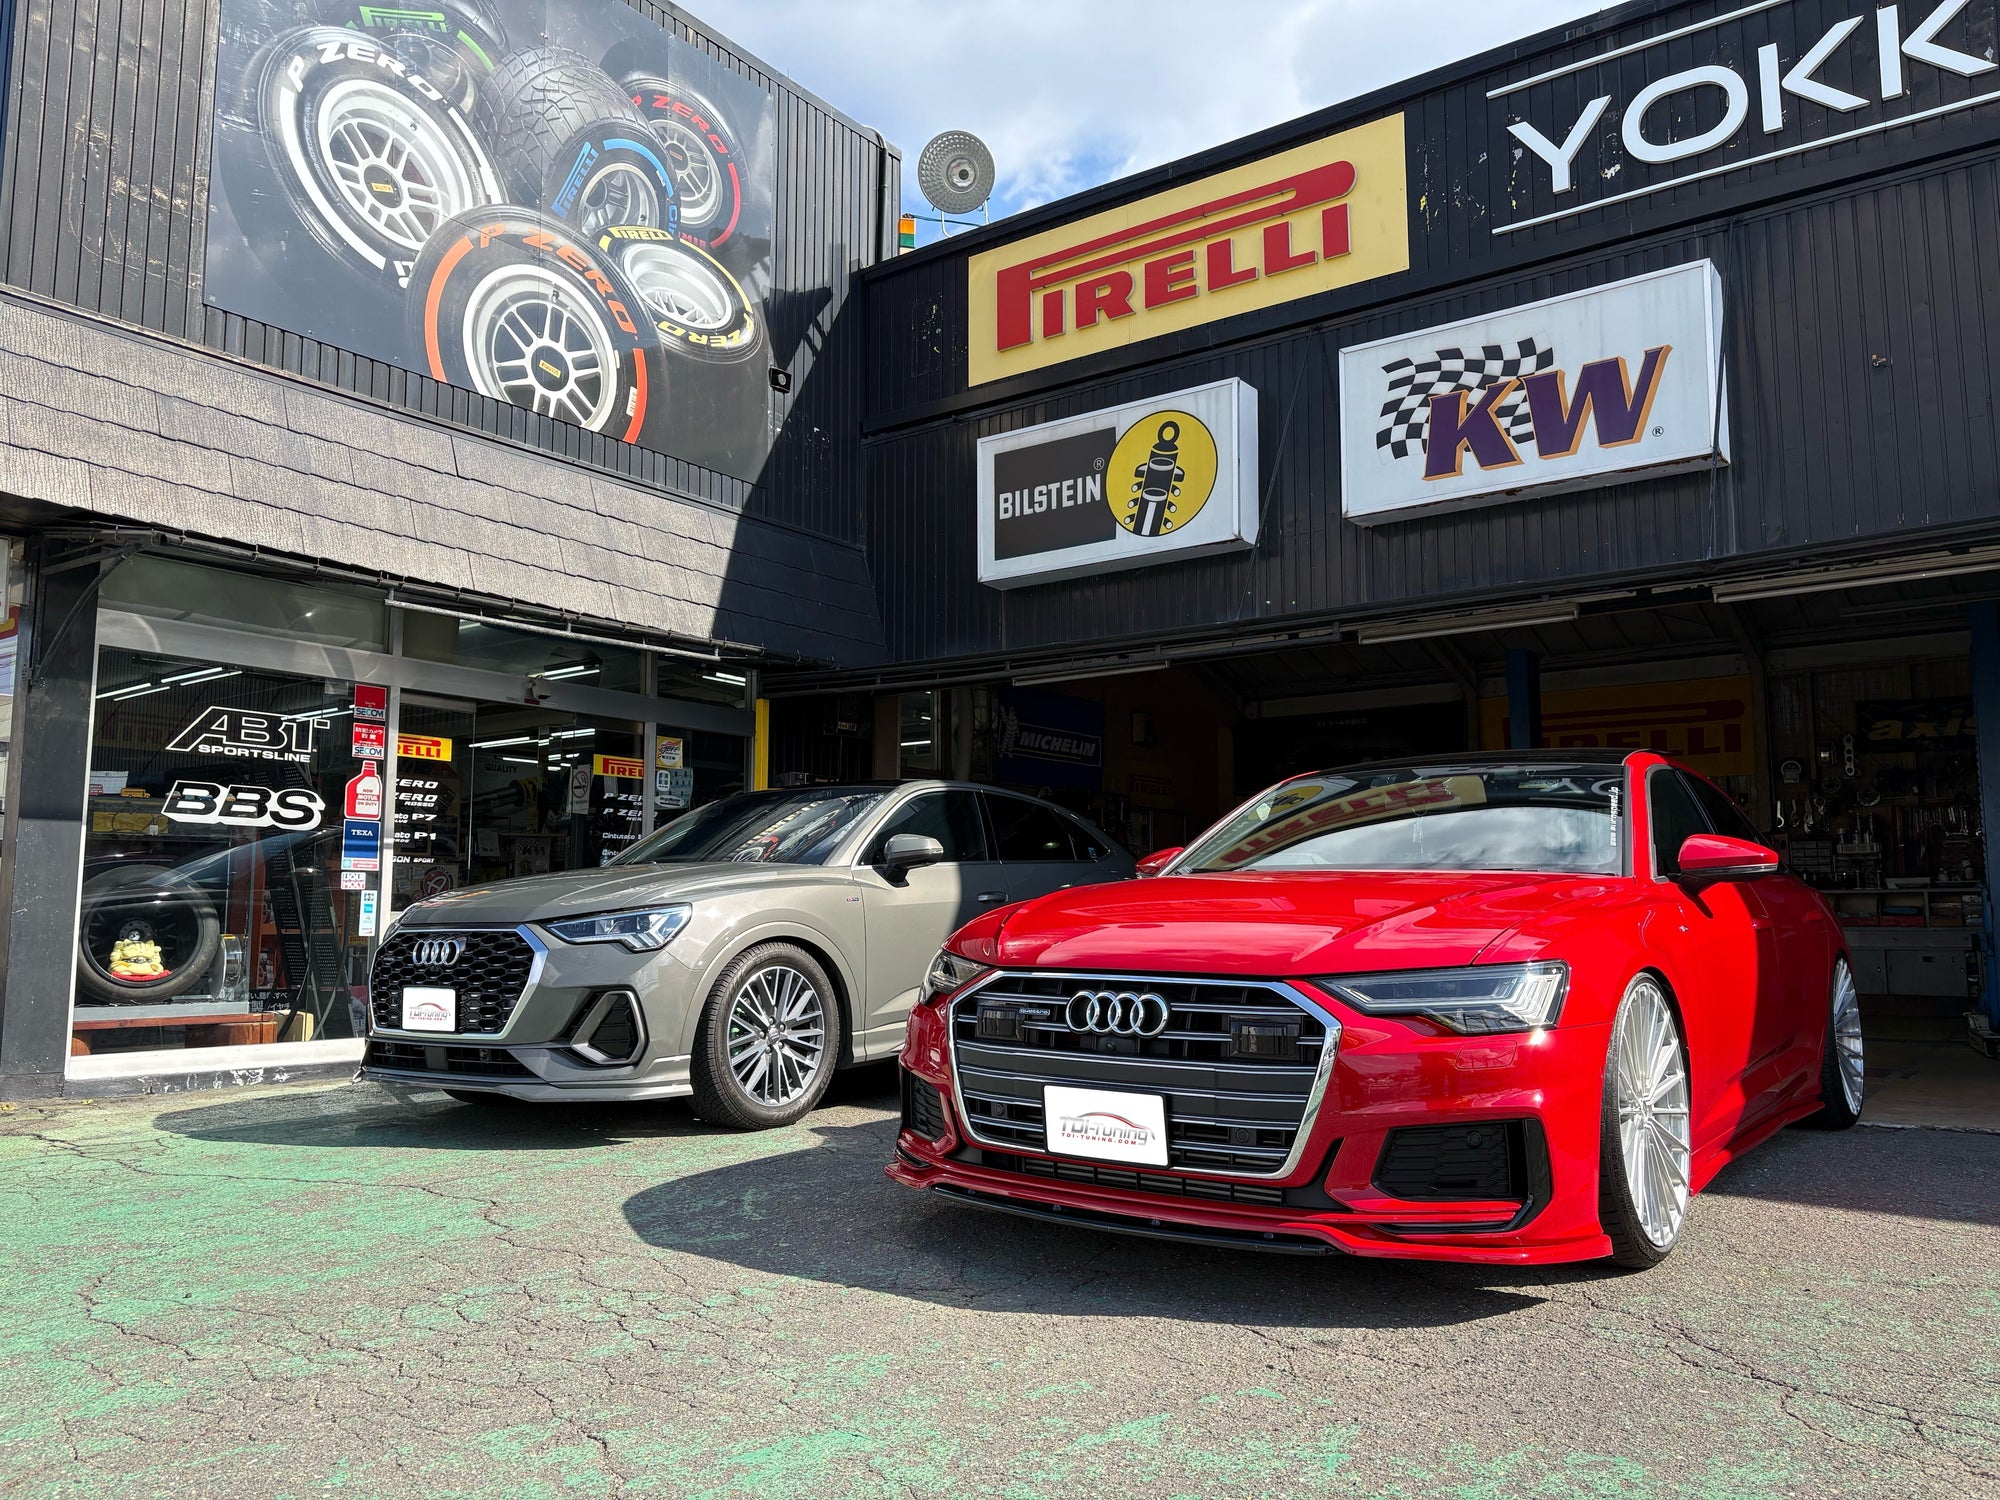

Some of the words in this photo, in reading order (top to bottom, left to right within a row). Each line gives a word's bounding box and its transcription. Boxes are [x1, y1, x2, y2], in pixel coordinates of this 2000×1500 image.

[317, 41, 443, 101] ZERO
[1507, 0, 1999, 194] YOKK
[652, 95, 728, 154] ZERO
[551, 141, 599, 220] PIRELLI
[607, 225, 674, 241] PIRELLI
[997, 160, 1357, 352] PIRELLI
[522, 228, 638, 334] ZERO
[1422, 344, 1673, 481] KW
[999, 473, 1101, 519] BILSTEIN
[356, 707, 384, 717] SECOM
[165, 705, 331, 753] ABT
[198, 744, 311, 763] SPORTSLINE
[354, 746, 382, 756] SECOM
[397, 736, 441, 758] ELLI
[1019, 730, 1097, 757] MICHELIN
[603, 758, 643, 777] PIREL
[395, 792, 438, 802] ERO
[396, 778, 439, 789] ERO
[161, 780, 326, 831] BBS
[414, 832, 436, 840] P1
[1061, 1132, 1137, 1145] TDI-TUNING.COM
